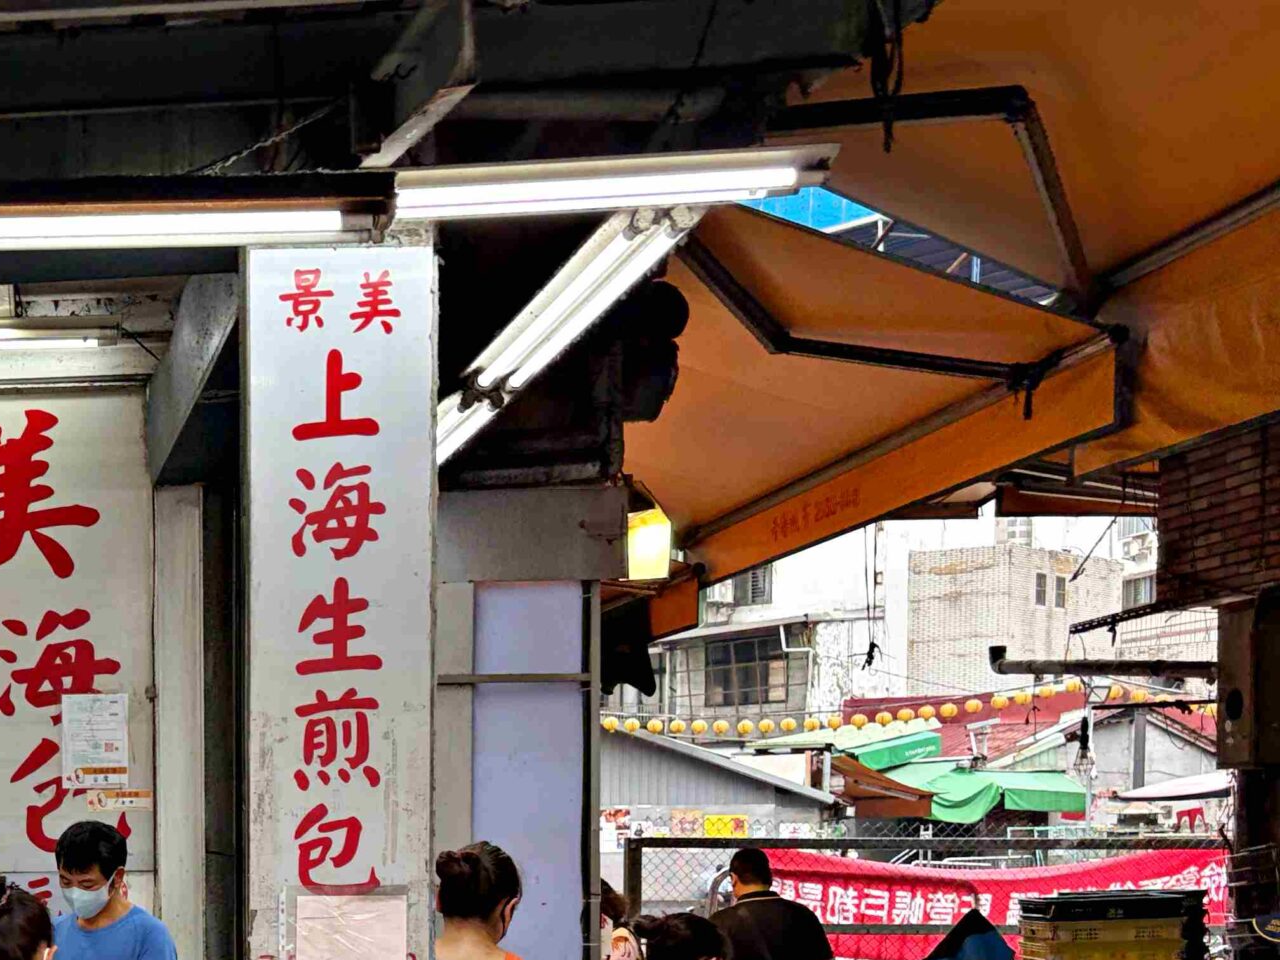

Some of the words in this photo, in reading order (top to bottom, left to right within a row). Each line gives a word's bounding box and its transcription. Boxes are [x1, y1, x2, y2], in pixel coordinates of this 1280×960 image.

[278, 268, 401, 334] 景美
[287, 348, 388, 898] 上海生煎包
